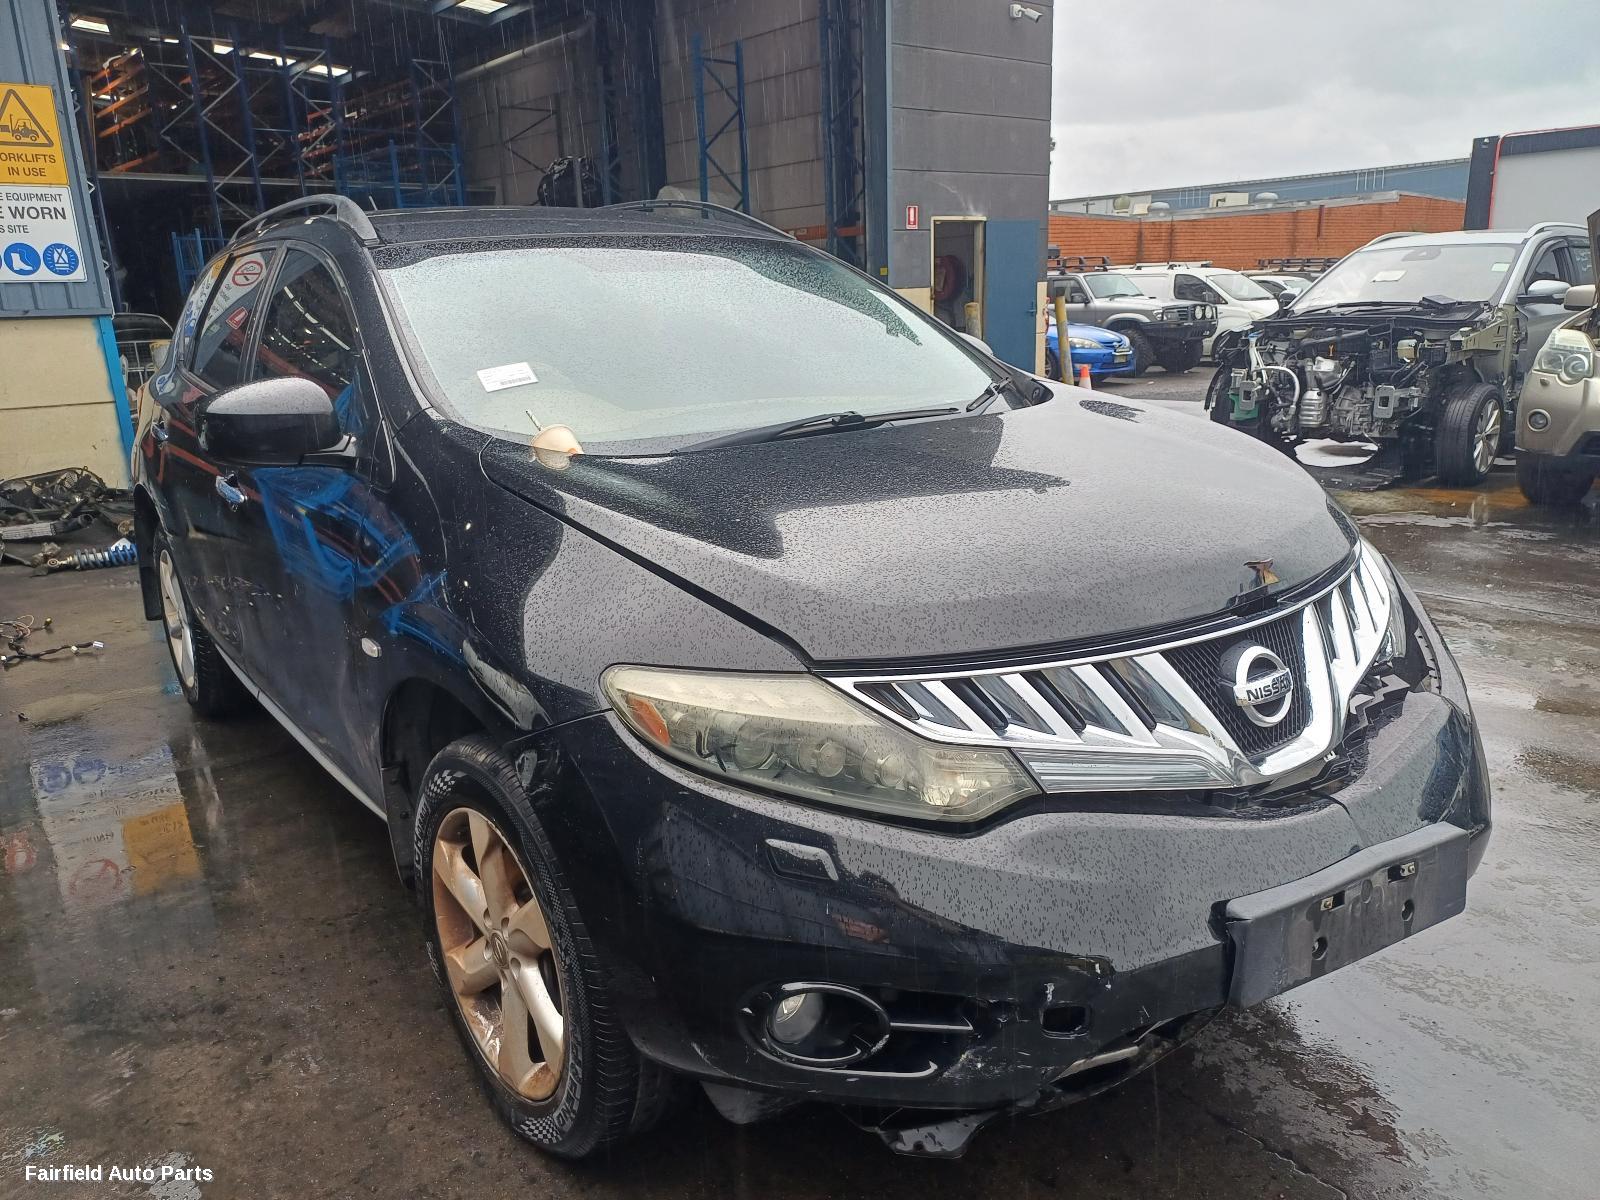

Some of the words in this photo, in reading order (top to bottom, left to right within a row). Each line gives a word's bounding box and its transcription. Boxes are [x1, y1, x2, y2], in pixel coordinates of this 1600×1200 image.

[8, 166, 20, 176] IN
[23, 167, 47, 177] USE
[6, 192, 63, 202] EQUIPMENT
[8, 206, 67, 220] WORN
[7, 225, 30, 234] SITE
[1246, 676, 1292, 702] NISSAN
